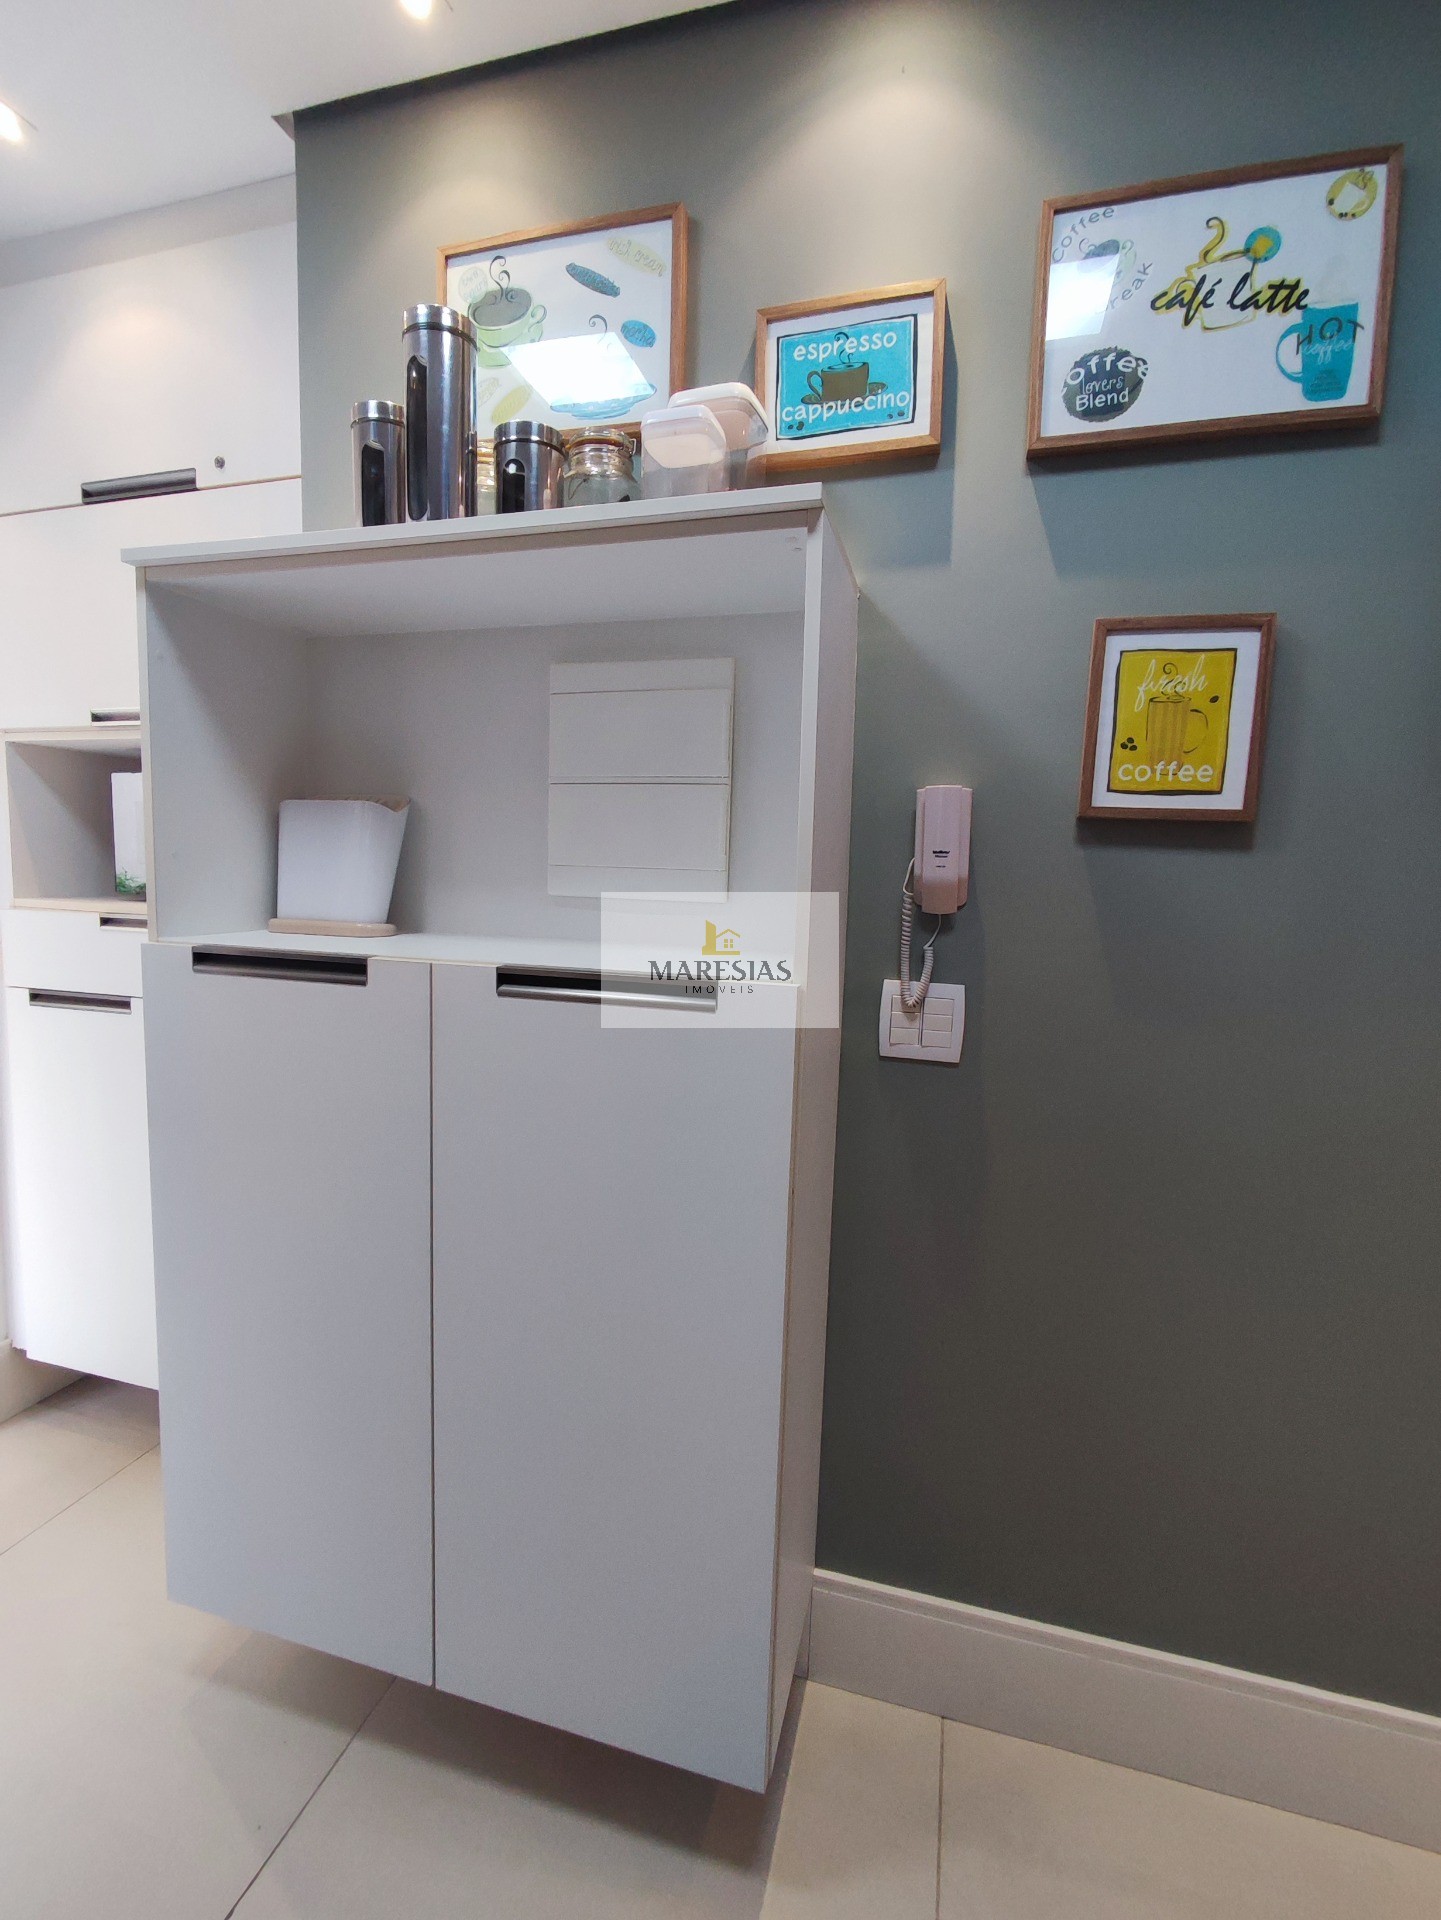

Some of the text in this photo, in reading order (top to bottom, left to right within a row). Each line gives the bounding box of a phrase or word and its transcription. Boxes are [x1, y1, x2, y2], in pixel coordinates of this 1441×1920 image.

[1096, 262, 1154, 316] reak
[1150, 272, 1311, 328] café latte
[793, 331, 898, 363] espresso
[1296, 317, 1366, 356] HOT
[1075, 387, 1130, 413] Blend
[1082, 376, 1125, 396] lovers
[781, 388, 911, 424] cappuccino
[1134, 653, 1209, 713] fresh
[1117, 760, 1214, 784] coffee
